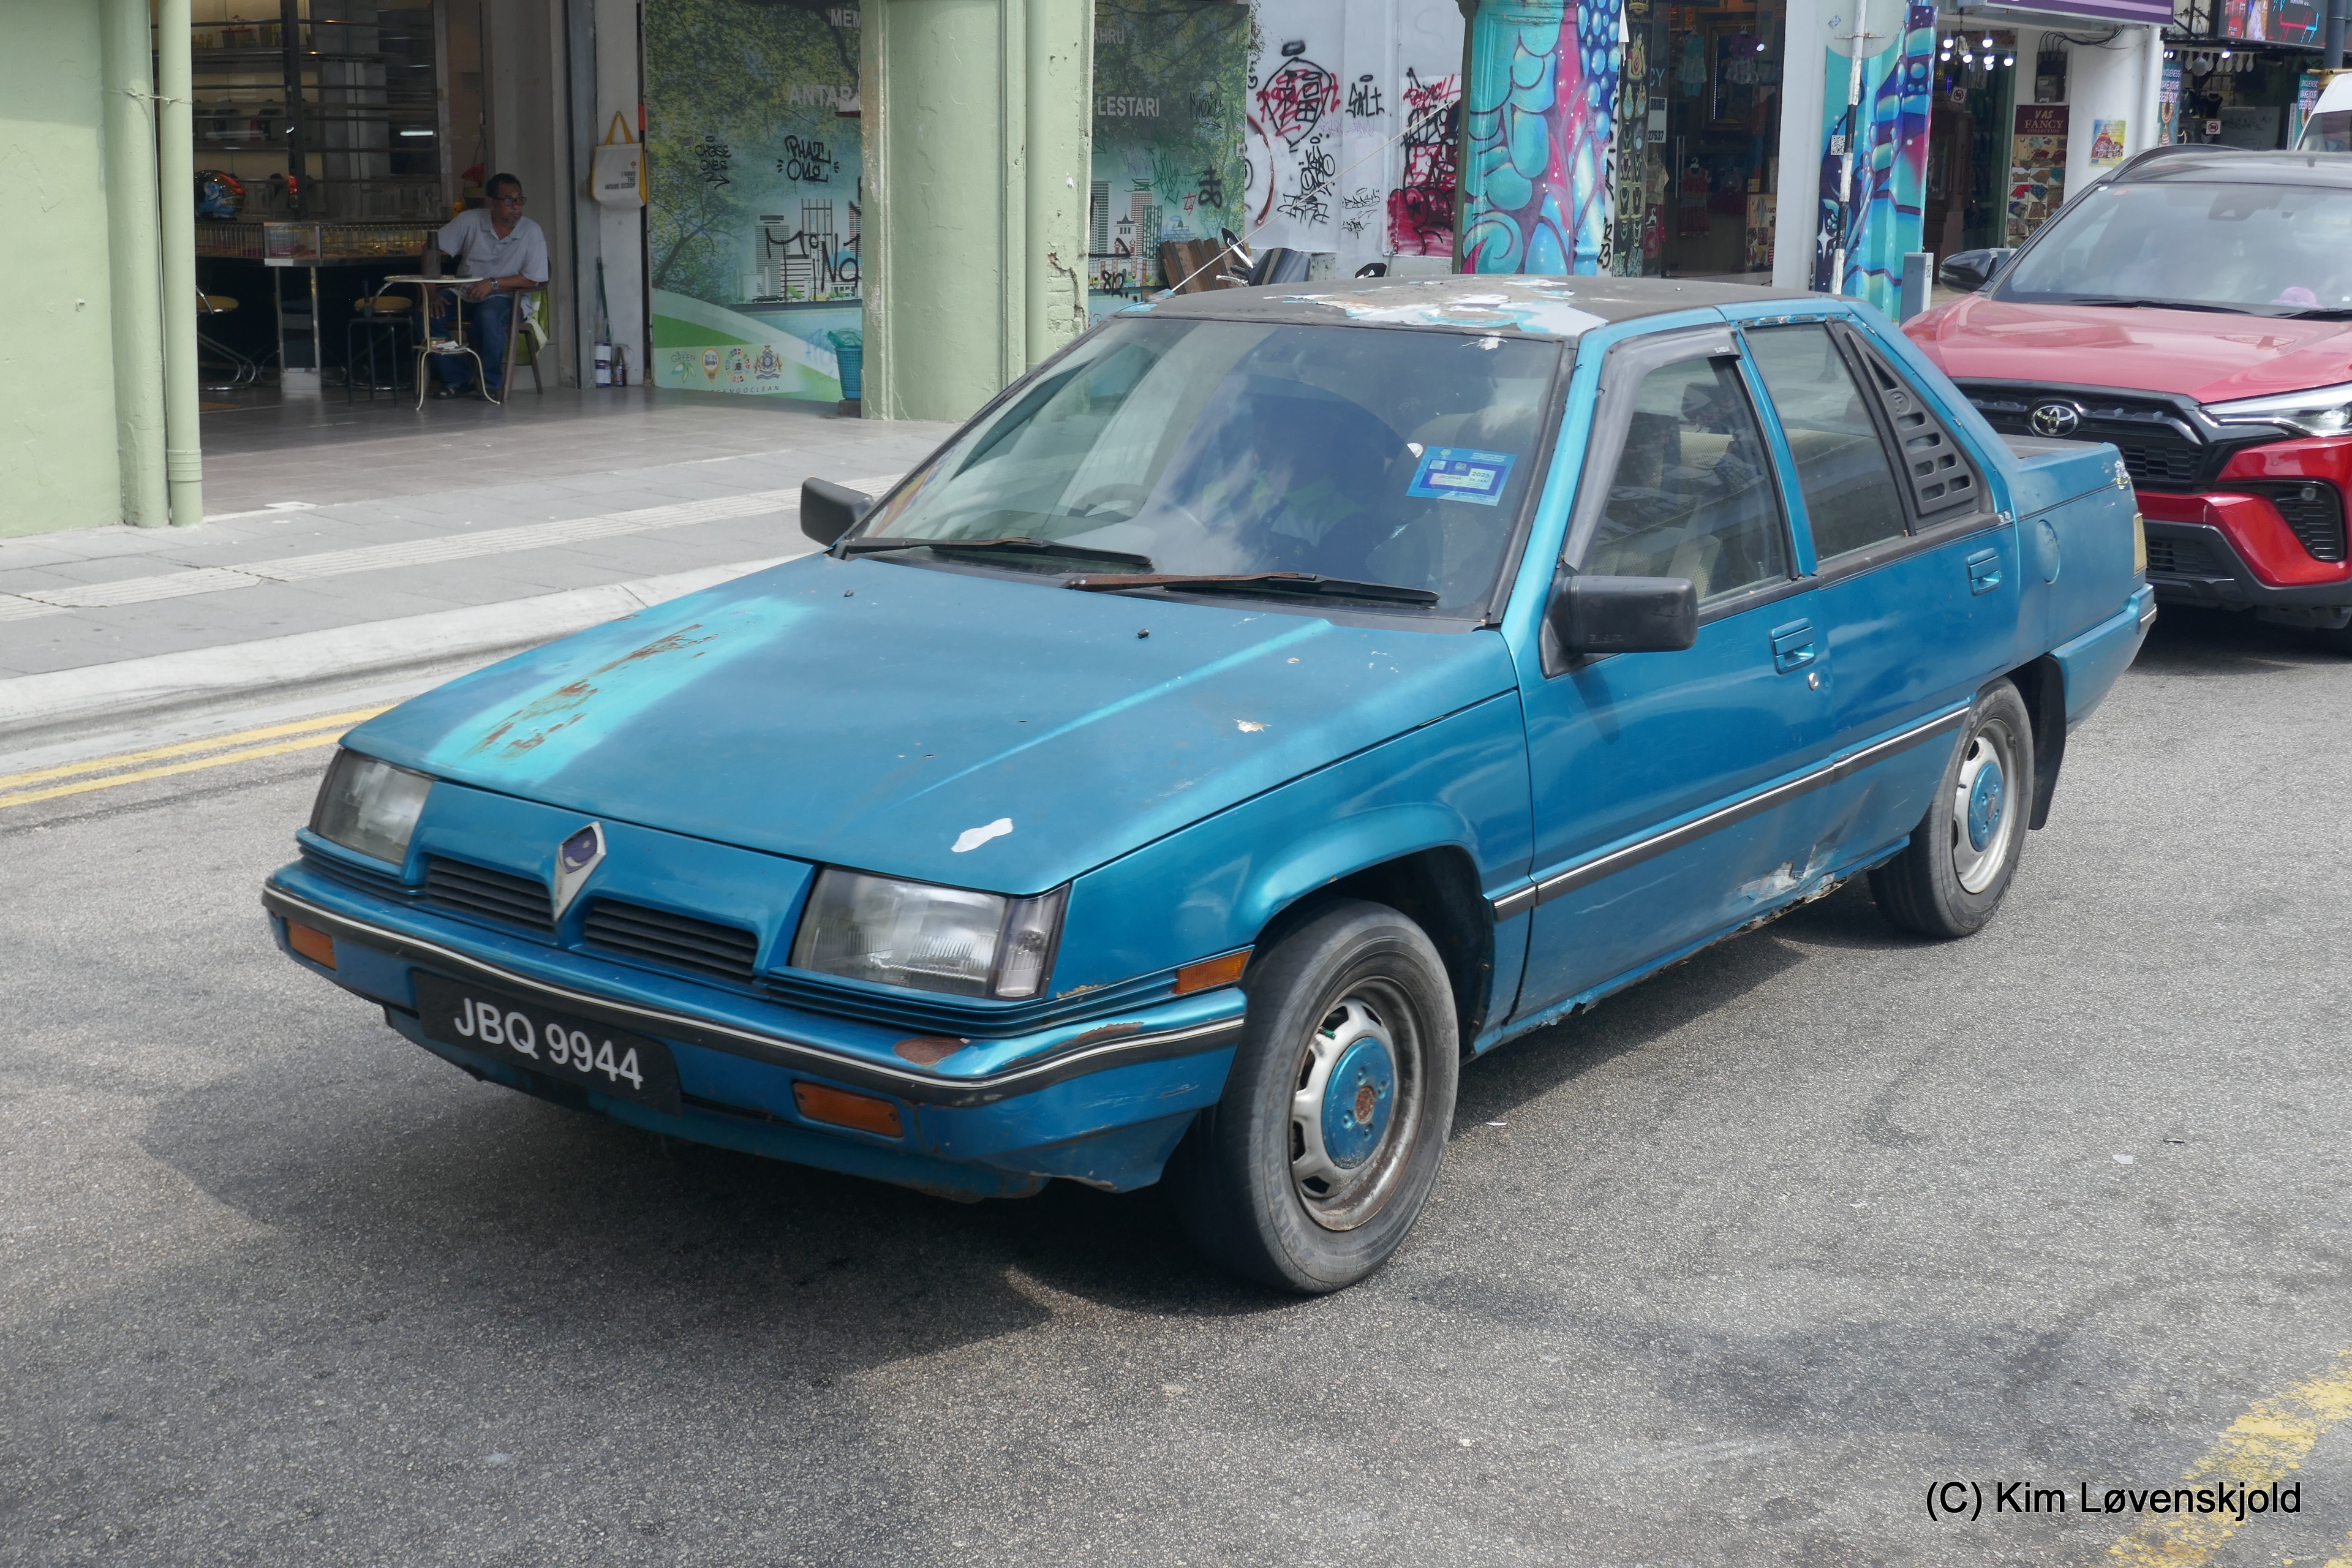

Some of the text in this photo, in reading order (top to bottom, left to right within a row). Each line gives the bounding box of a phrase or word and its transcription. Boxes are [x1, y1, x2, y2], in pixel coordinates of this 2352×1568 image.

[1097, 96, 1159, 117] LESTARI
[2024, 119, 2064, 129] FANCY
[1470, 452, 1507, 462] 365
[453, 997, 540, 1060] JBQ
[545, 1023, 644, 1090] 9944
